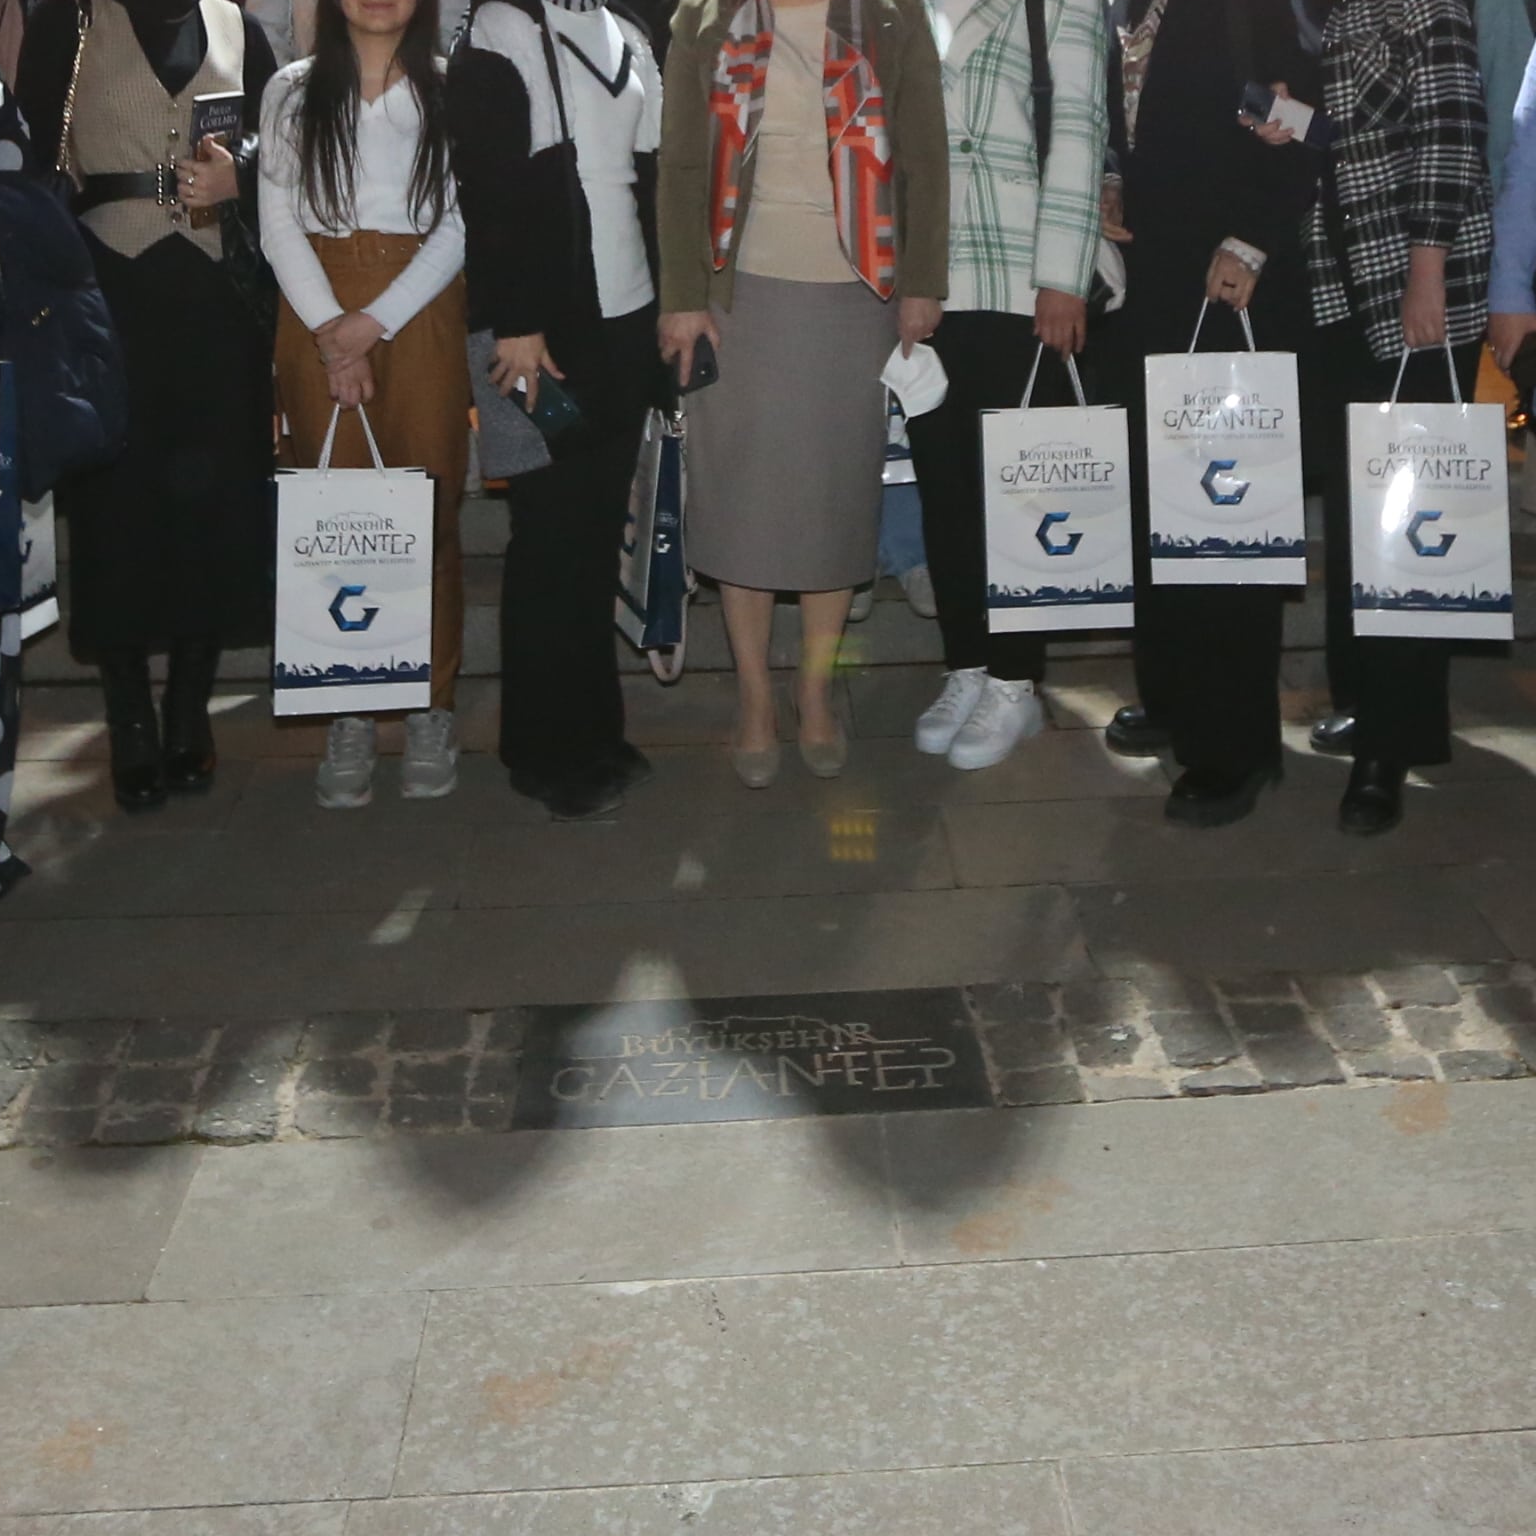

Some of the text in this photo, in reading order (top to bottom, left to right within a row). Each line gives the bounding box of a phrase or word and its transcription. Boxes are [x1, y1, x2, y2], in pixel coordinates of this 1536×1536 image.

[1000, 461, 1115, 485] GAZİANTEP
[294, 532, 416, 558] GAZİANTEP
[549, 1047, 956, 1105] GAZİANTEP
